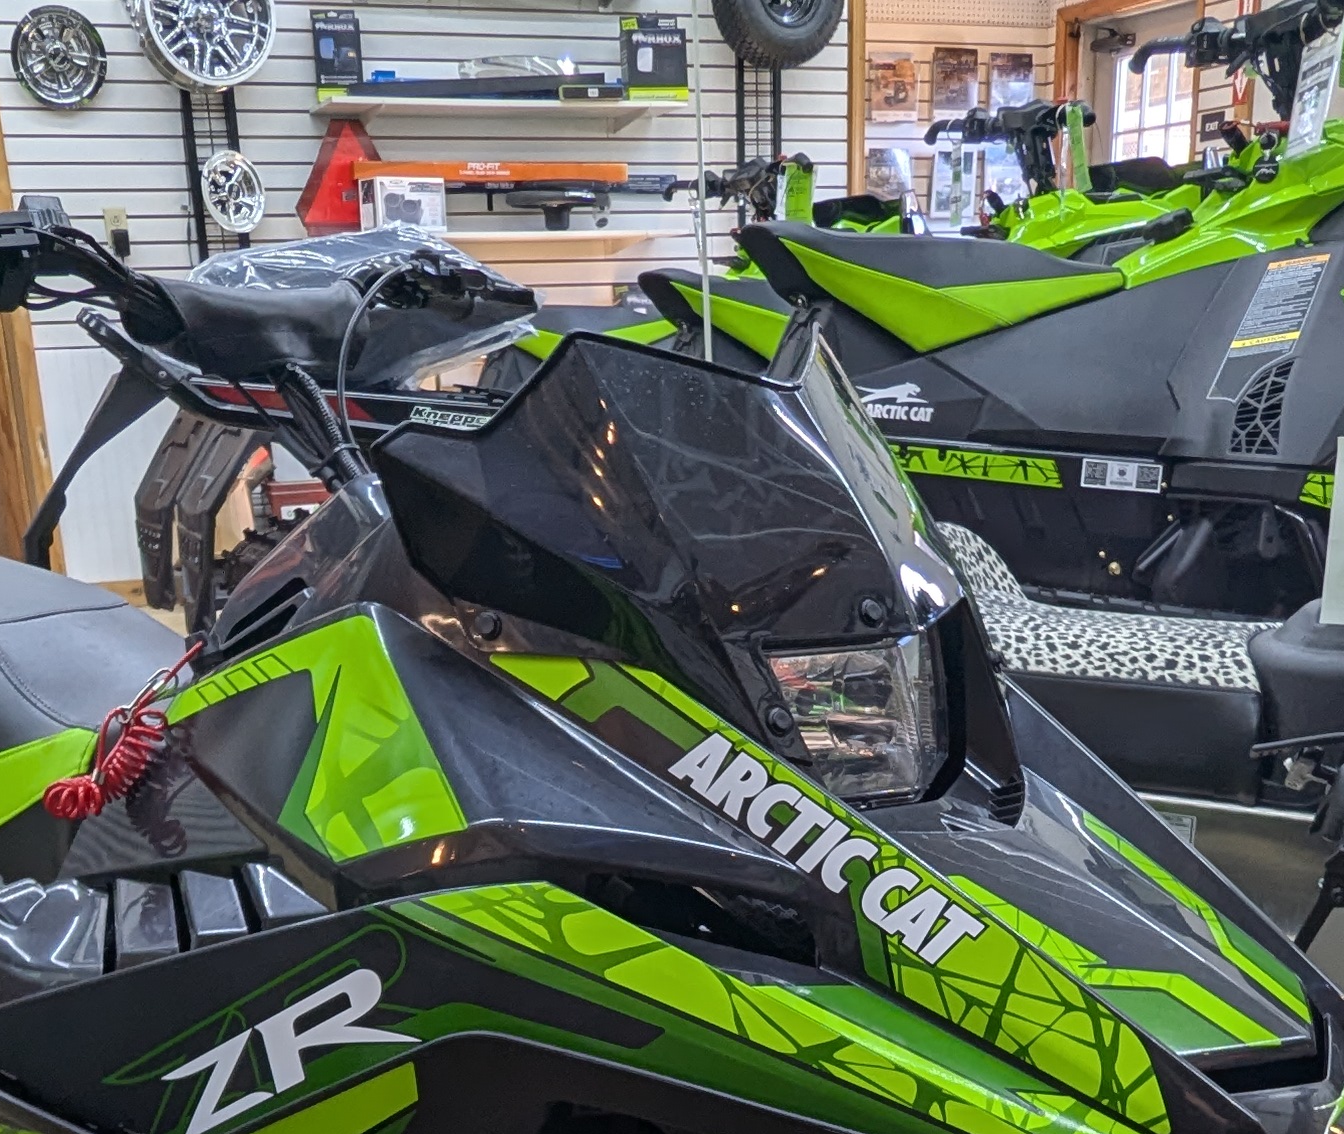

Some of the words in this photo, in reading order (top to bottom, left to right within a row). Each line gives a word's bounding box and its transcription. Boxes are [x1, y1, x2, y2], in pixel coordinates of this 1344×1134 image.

[862, 403, 909, 420] ARCTIC
[909, 406, 935, 422] CAT
[668, 732, 879, 894] ARCTIC
[861, 868, 986, 965] CAT
